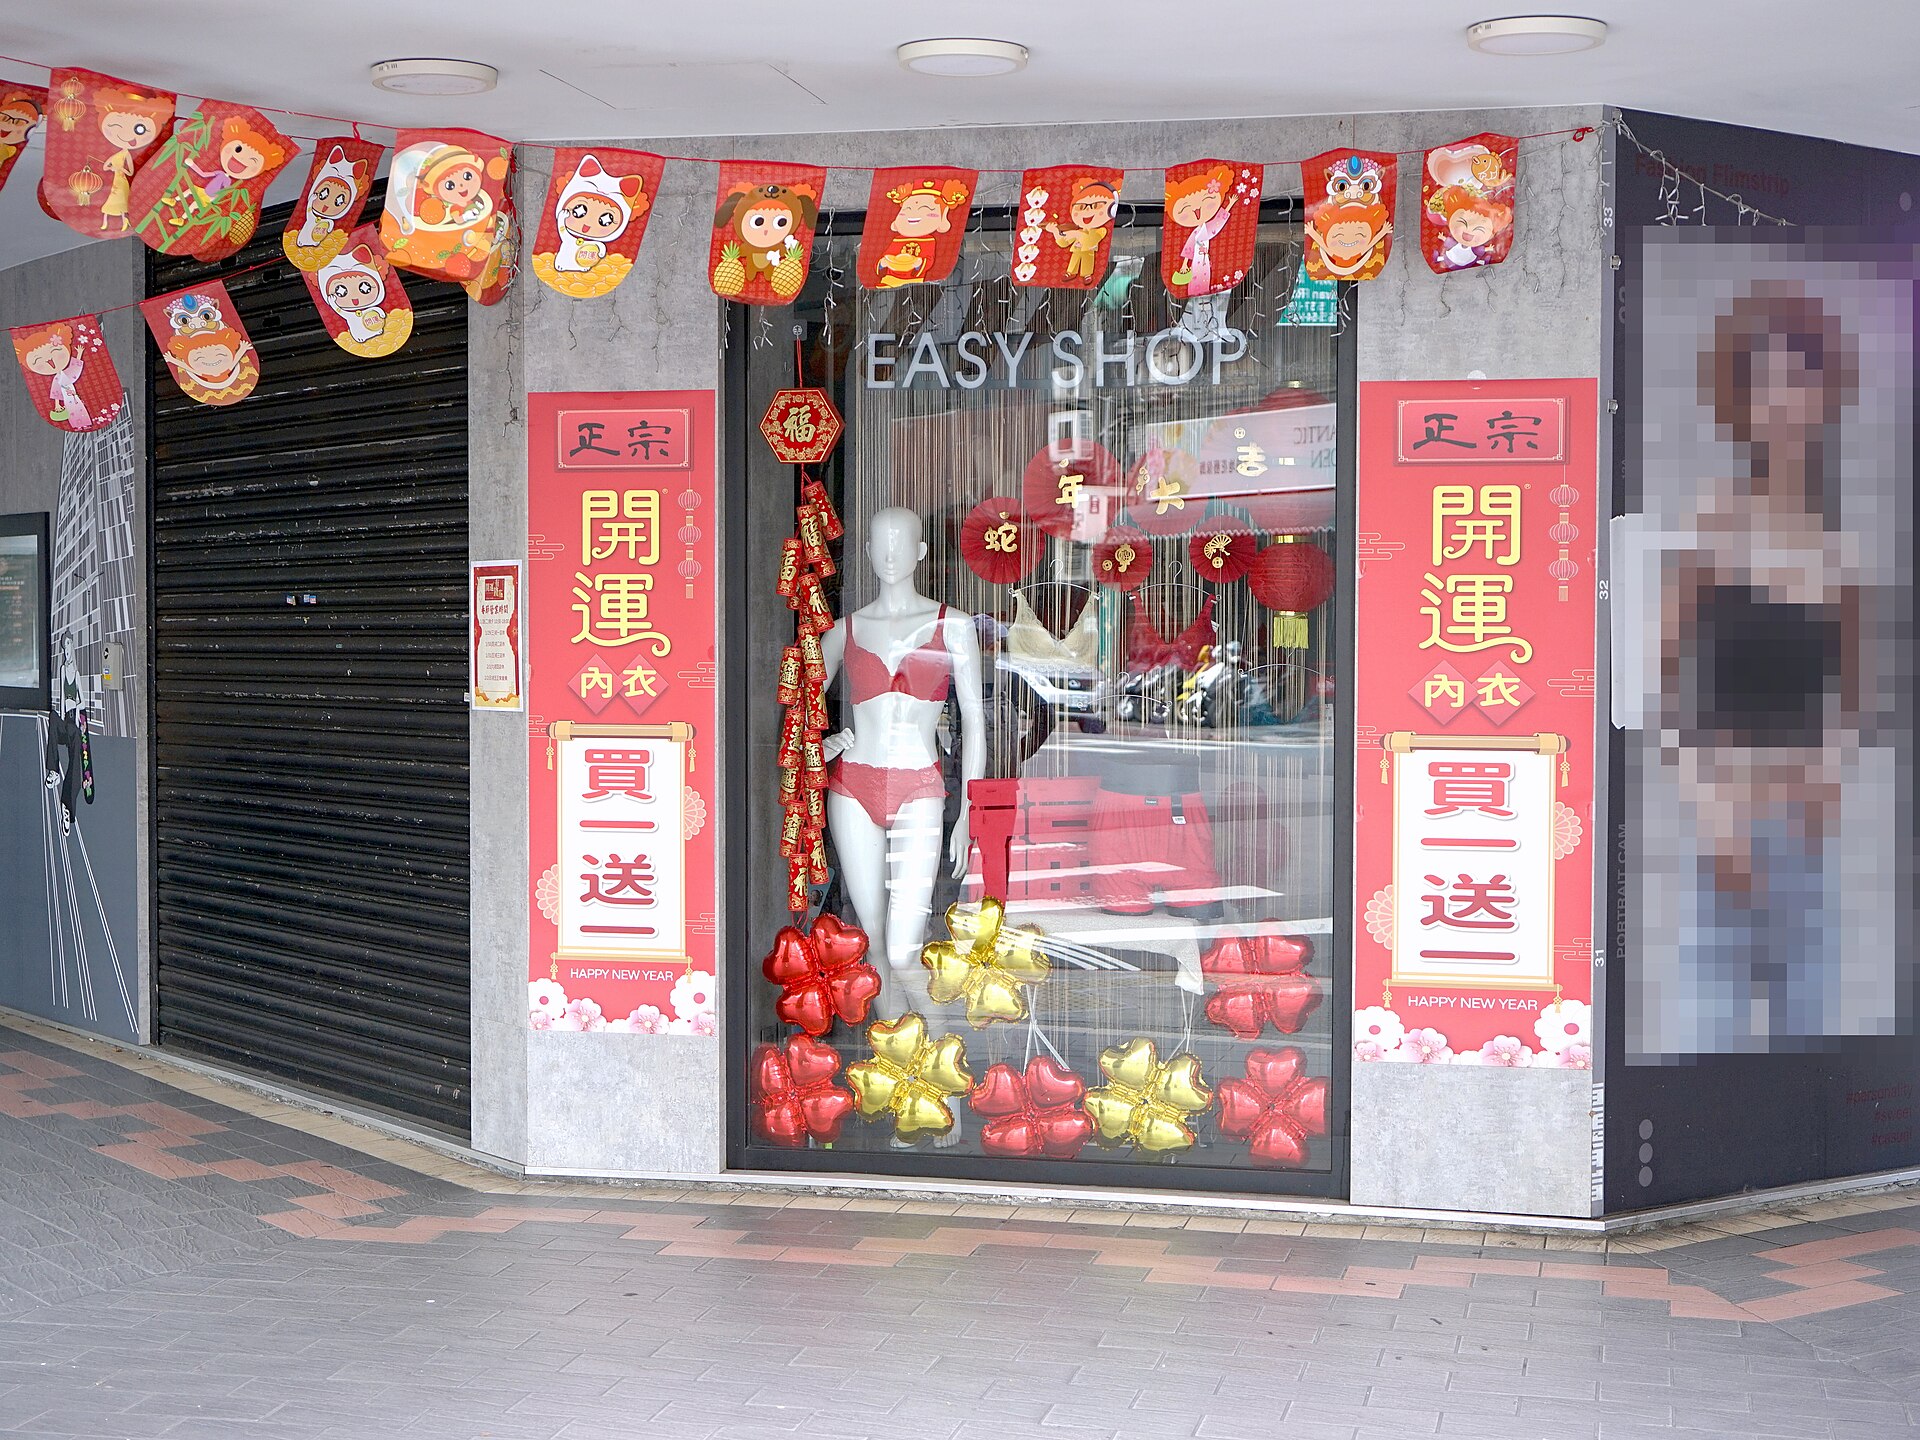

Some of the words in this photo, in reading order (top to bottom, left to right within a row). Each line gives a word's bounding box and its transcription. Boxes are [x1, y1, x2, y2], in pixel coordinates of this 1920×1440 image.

[1603, 206, 1614, 227] 33
[867, 330, 1034, 389] EASY
[1051, 328, 1248, 389] SHOP
[570, 420, 672, 461] 正宗
[783, 405, 817, 443] 福
[1413, 411, 1542, 454] 正宗
[1055, 474, 1090, 510] 年
[1149, 477, 1185, 515] 大
[983, 523, 1019, 554] 蛇
[570, 489, 672, 658] 開運
[1418, 485, 1534, 665] 開運
[1599, 579, 1609, 600] 32
[580, 665, 658, 699] 內衣
[1424, 672, 1521, 709] 內衣
[579, 748, 656, 935] 買一送一
[1419, 761, 1517, 960] 買一送一
[570, 967, 609, 980] HAPPY
[612, 968, 641, 981] NEW
[642, 969, 674, 982] YEAR
[1595, 949, 1605, 967] 31
[1407, 995, 1458, 1009] HAPPY
[1461, 996, 1496, 1010] NEW
[1498, 998, 1538, 1011] YEAR
